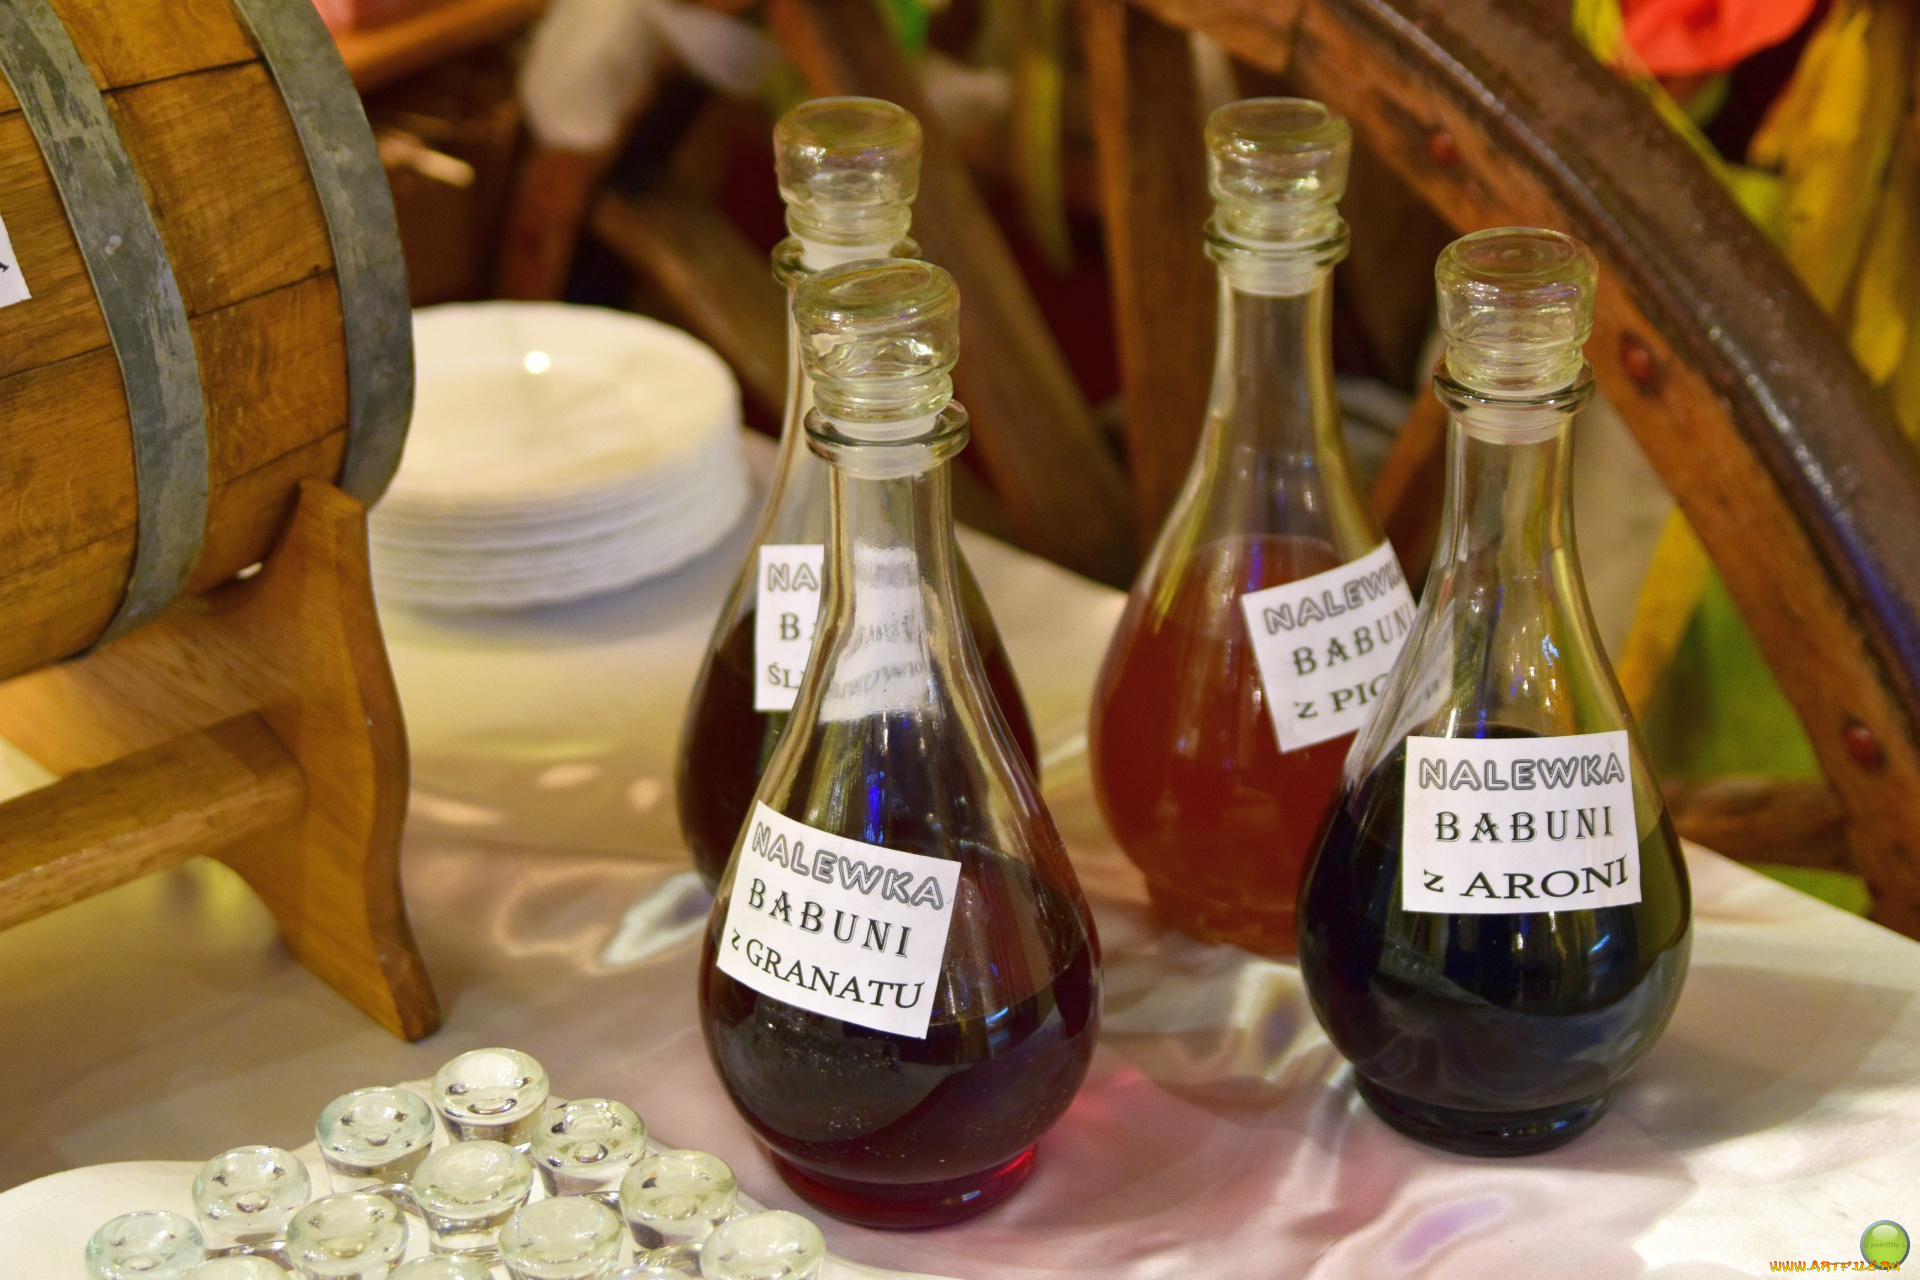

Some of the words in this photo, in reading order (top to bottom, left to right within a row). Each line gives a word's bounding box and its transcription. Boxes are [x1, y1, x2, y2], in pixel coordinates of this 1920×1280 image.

[768, 562, 823, 592] NA
[1263, 559, 1403, 635] NALEWK
[768, 662, 804, 689] ŚL
[1419, 752, 1625, 791] NALEWKA
[1435, 806, 1614, 843] BABUNI
[751, 821, 944, 910] NALEWKA
[1459, 853, 1628, 899] ARONI
[748, 878, 913, 958] BABUNI
[746, 938, 926, 1009] GRANATU
